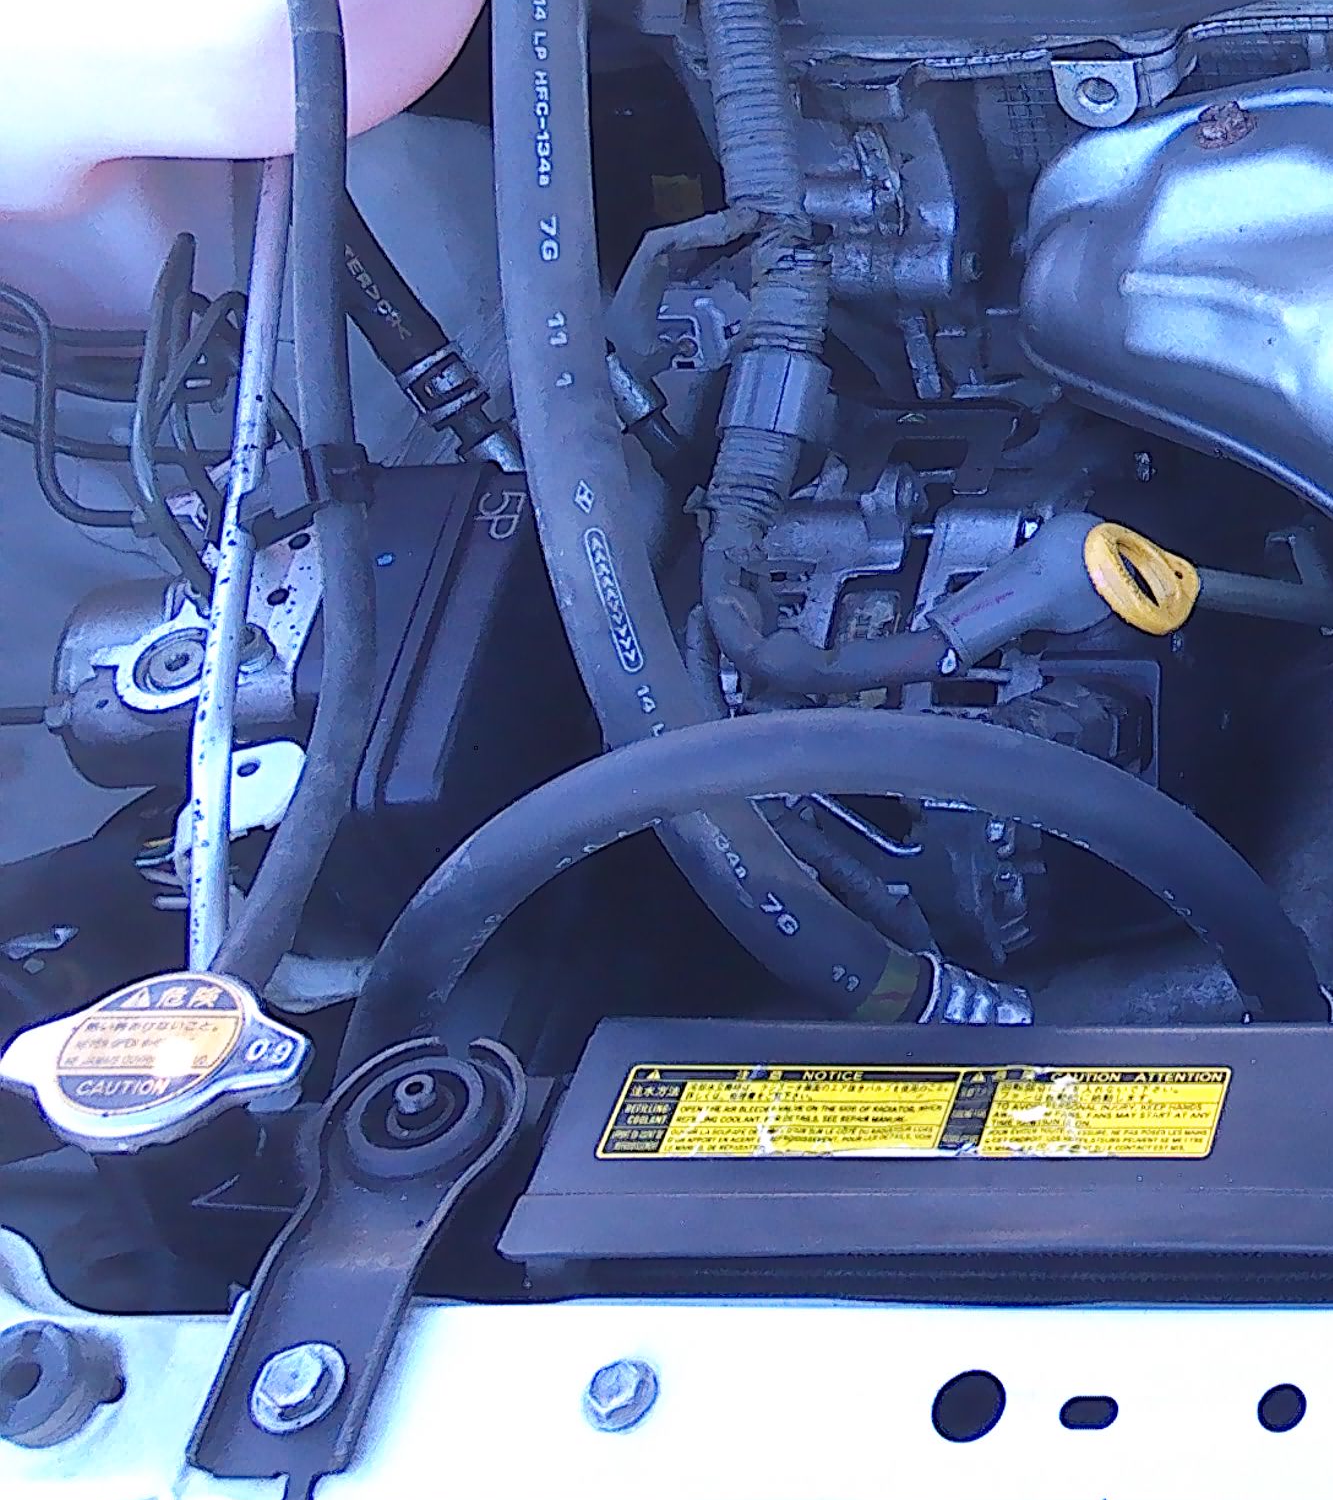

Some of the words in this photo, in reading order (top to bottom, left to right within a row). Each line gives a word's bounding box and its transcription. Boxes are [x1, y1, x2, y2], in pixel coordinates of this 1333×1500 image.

[800, 1071, 864, 1081] NOTICE
[1134, 1071, 1223, 1082] ATTENTION
[76, 1078, 170, 1097] CAUTION
